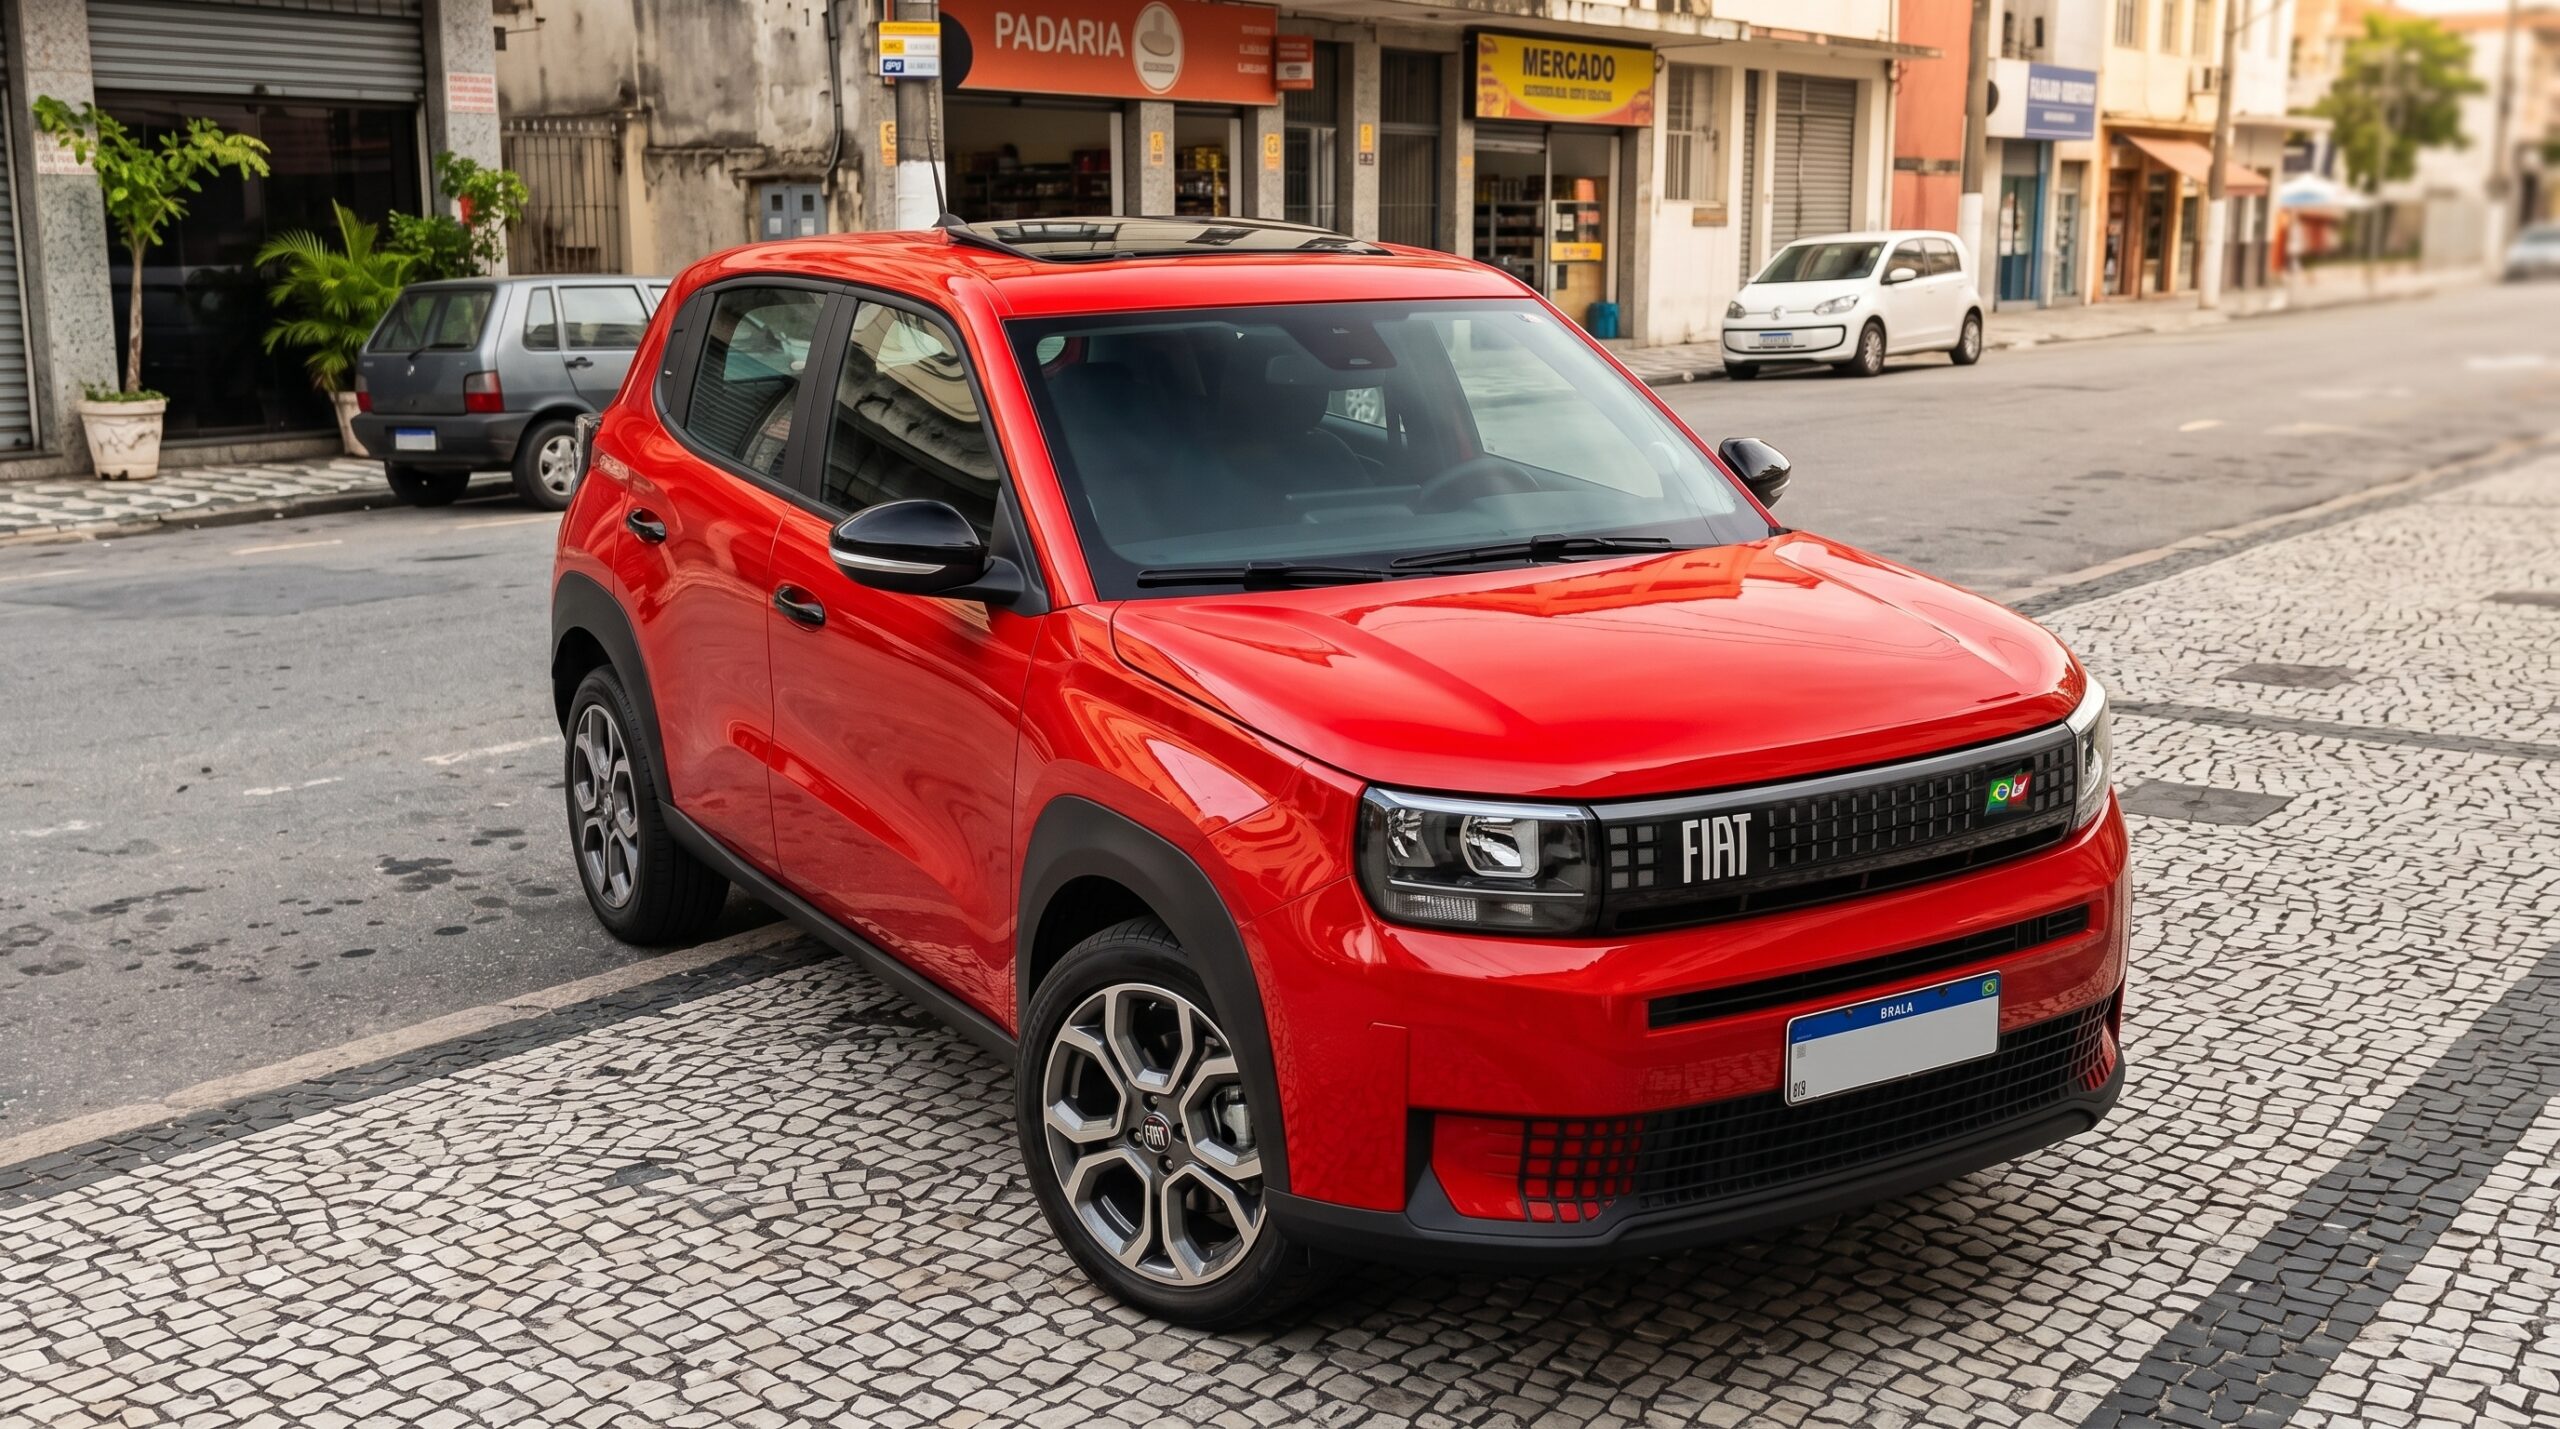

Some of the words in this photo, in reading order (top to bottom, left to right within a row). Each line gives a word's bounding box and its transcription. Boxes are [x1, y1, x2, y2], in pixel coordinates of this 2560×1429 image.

[995, 12, 1124, 58] PADARIA
[1523, 47, 1615, 83] MERCADO
[1682, 812, 1752, 884] FIAT
[1880, 1001, 1913, 1020] BRALA
[1144, 1124, 1165, 1146] FIAT
